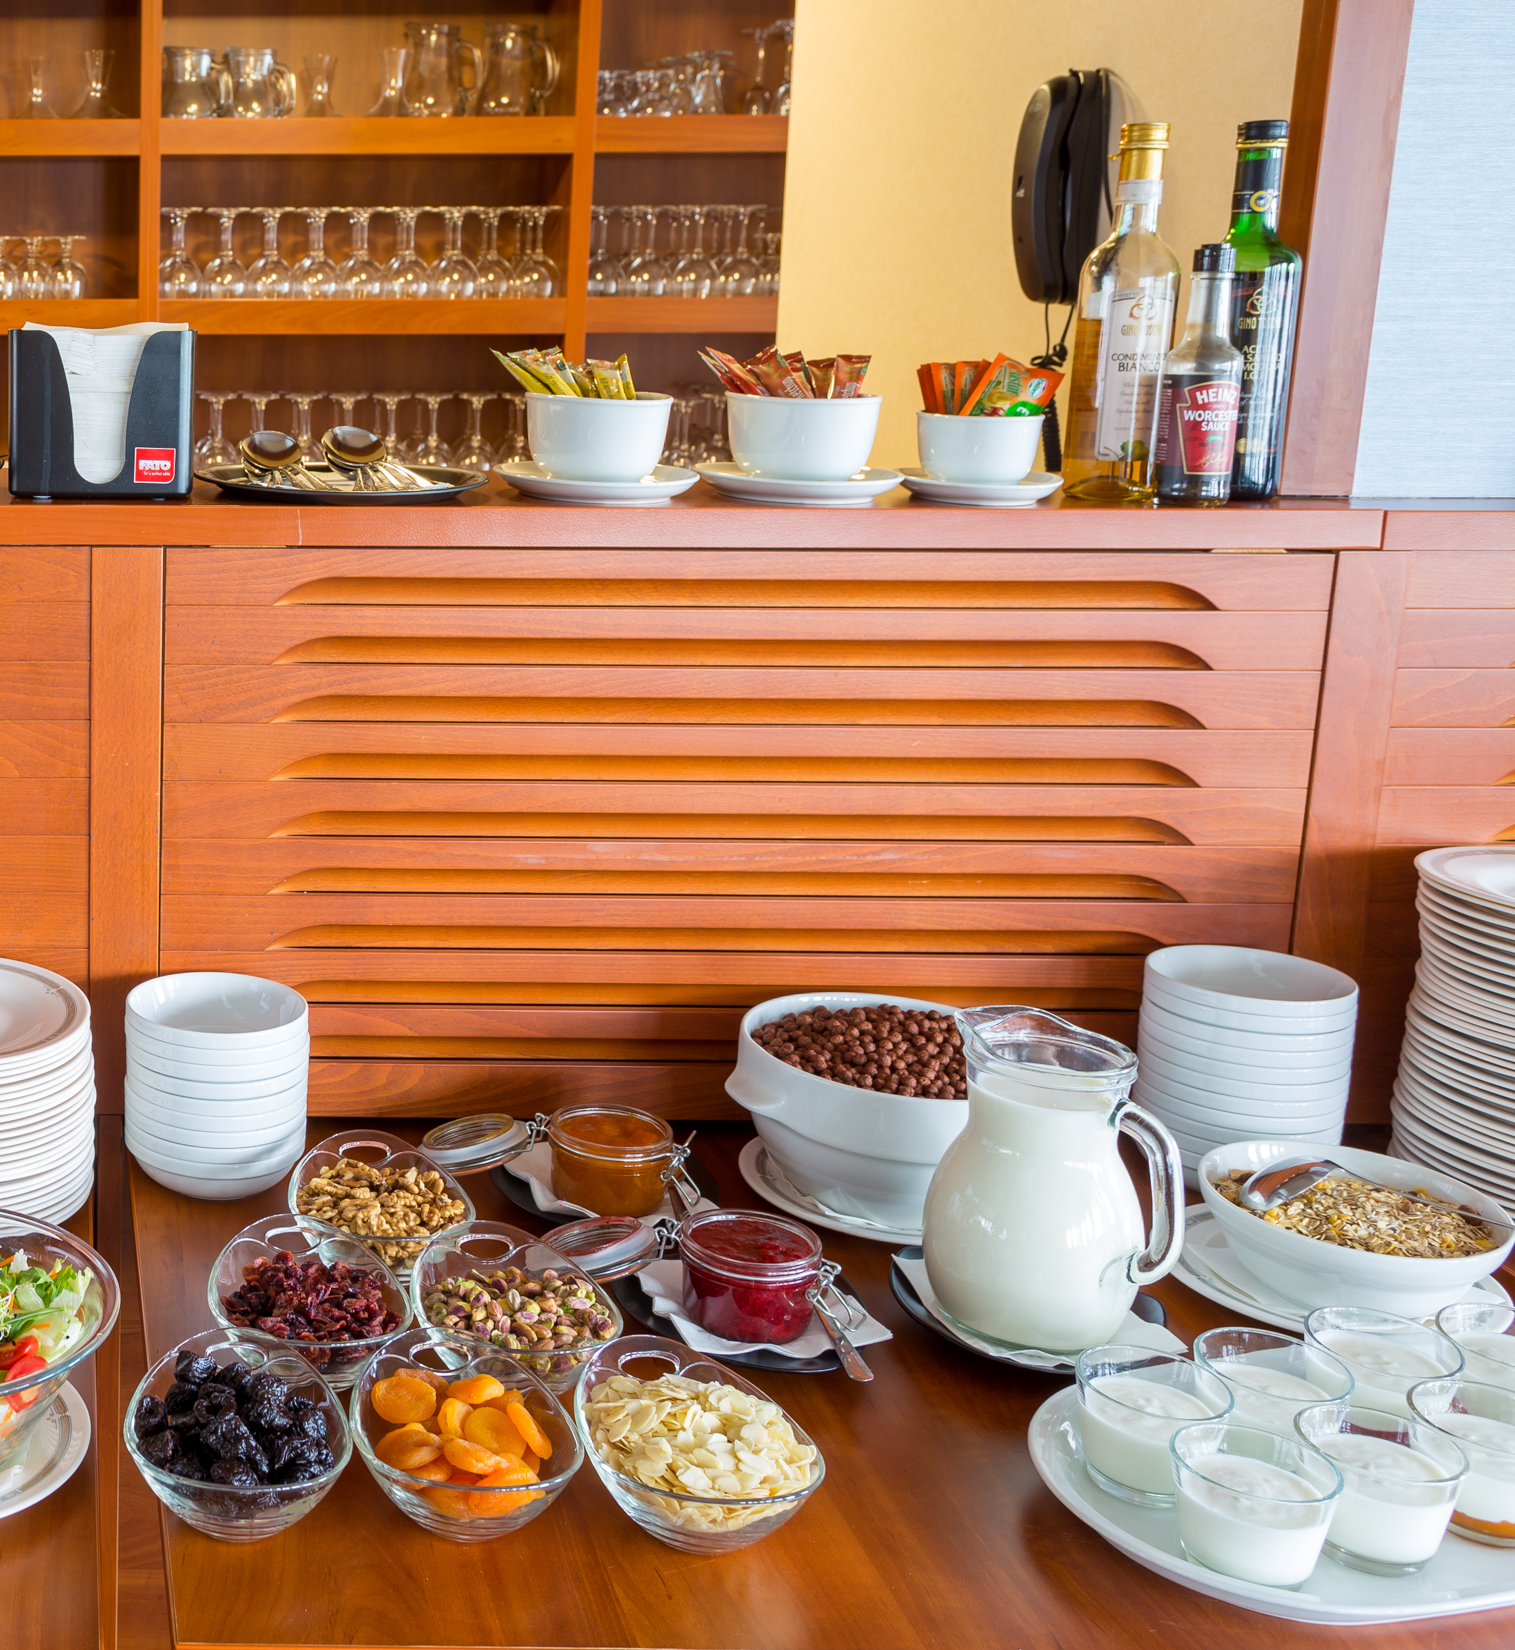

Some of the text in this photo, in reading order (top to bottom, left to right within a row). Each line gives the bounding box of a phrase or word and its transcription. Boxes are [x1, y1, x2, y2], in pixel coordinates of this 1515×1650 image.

[1117, 362, 1161, 372] BIANCO
[1195, 388, 1238, 405] HEINZ
[1200, 421, 1230, 431] SAUCE
[138, 460, 171, 470] FATO
